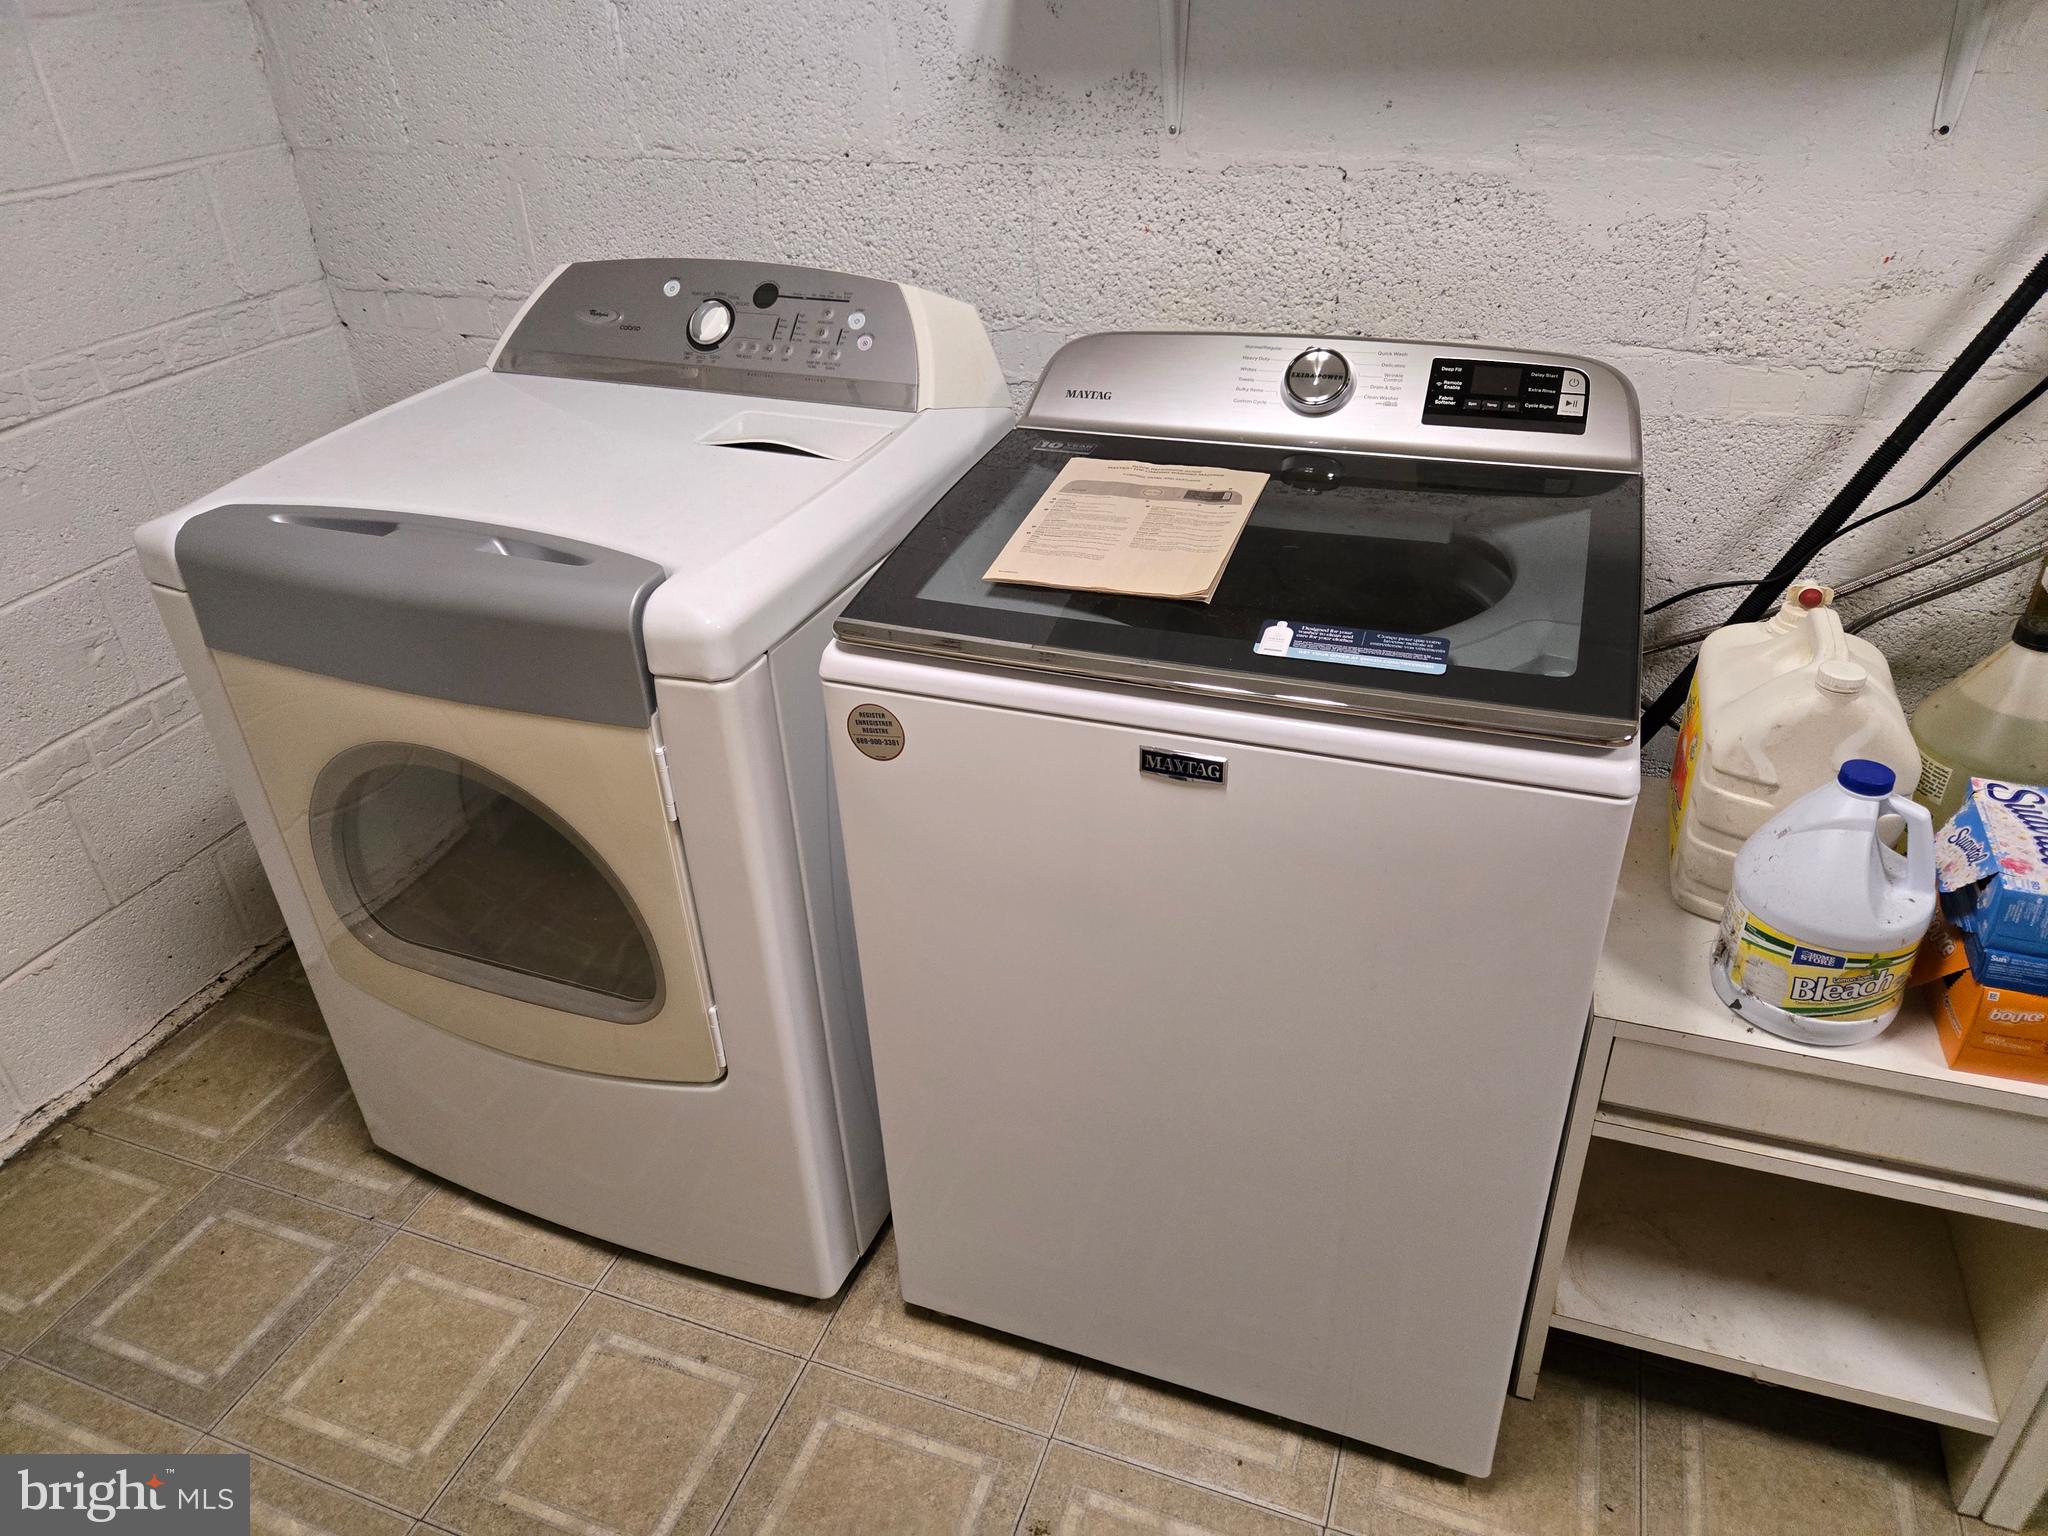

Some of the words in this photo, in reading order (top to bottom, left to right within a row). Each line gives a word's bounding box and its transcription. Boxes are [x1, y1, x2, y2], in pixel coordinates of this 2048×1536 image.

[1317, 373, 1344, 381] POWER
[1065, 389, 1112, 401] MAYTAG
[1524, 402, 1539, 410] Cycle
[858, 711, 886, 720] REGISTER
[862, 727, 889, 735] REGISTRE
[1145, 754, 1220, 778] MAYTAG
[1947, 827, 1988, 867] Suavitel
[1800, 953, 1836, 968] STORE
[1809, 951, 1836, 962] HOME
[1990, 954, 2007, 964] Sun
[1790, 967, 1895, 1002] Bleach
[1832, 976, 1857, 984] Lemon
[1989, 1008, 2046, 1023] bounce
